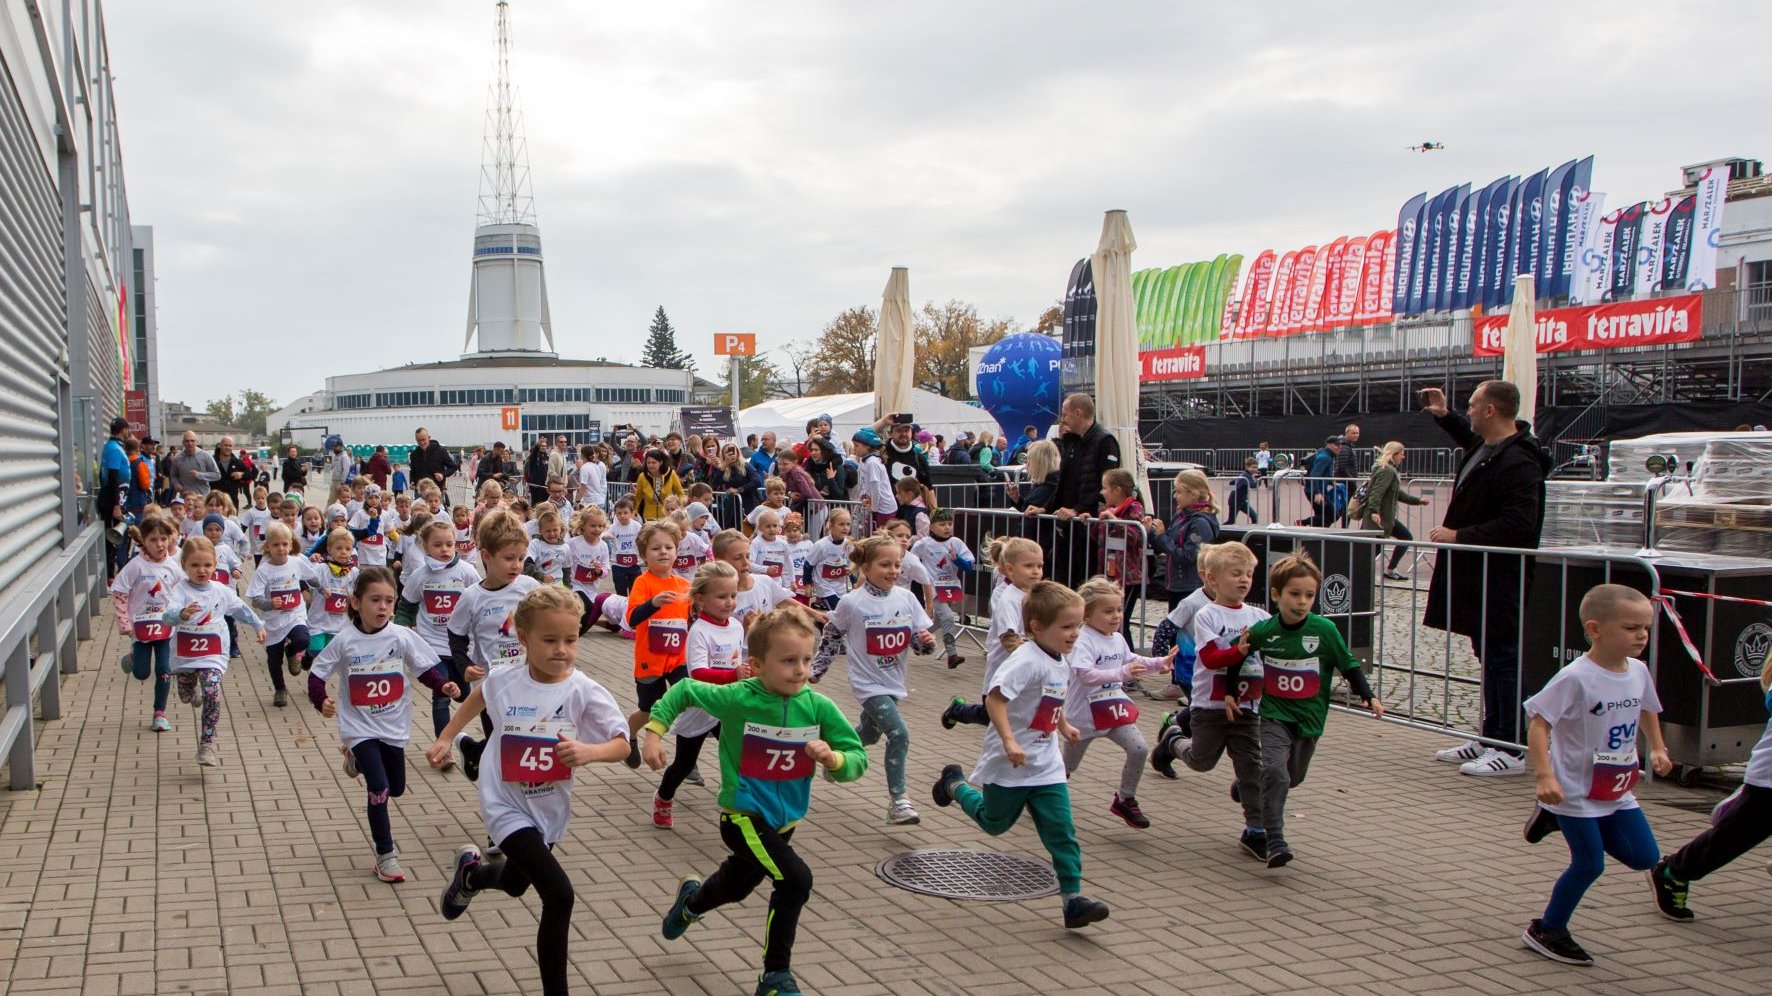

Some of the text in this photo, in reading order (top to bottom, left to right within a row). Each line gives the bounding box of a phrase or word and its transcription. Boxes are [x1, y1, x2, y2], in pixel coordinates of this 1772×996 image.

[1562, 214, 1578, 275] HYUNDAI
[1396, 242, 1413, 298] HYUNDAI
[1457, 236, 1474, 293] HYUNDAI
[1587, 305, 1689, 341] terravita
[1482, 316, 1567, 349] terita
[1151, 352, 1201, 376] terravita
[505, 410, 515, 425] 11
[621, 540, 633, 550] gvt
[622, 556, 633, 564] 50
[677, 558, 688, 566] 30
[830, 568, 842, 576] 60
[945, 589, 953, 599] 3
[334, 598, 347, 609] 64
[434, 595, 452, 609] 25
[145, 623, 163, 636] 72
[190, 638, 209, 652] 22
[662, 633, 680, 648] 78
[876, 631, 906, 650] 100
[366, 679, 391, 698] 20
[1277, 675, 1305, 692] 80
[506, 706, 517, 716] 21
[1108, 703, 1130, 720] 14
[747, 724, 760, 734] 200
[519, 746, 554, 772] 45
[766, 748, 796, 772] 73
